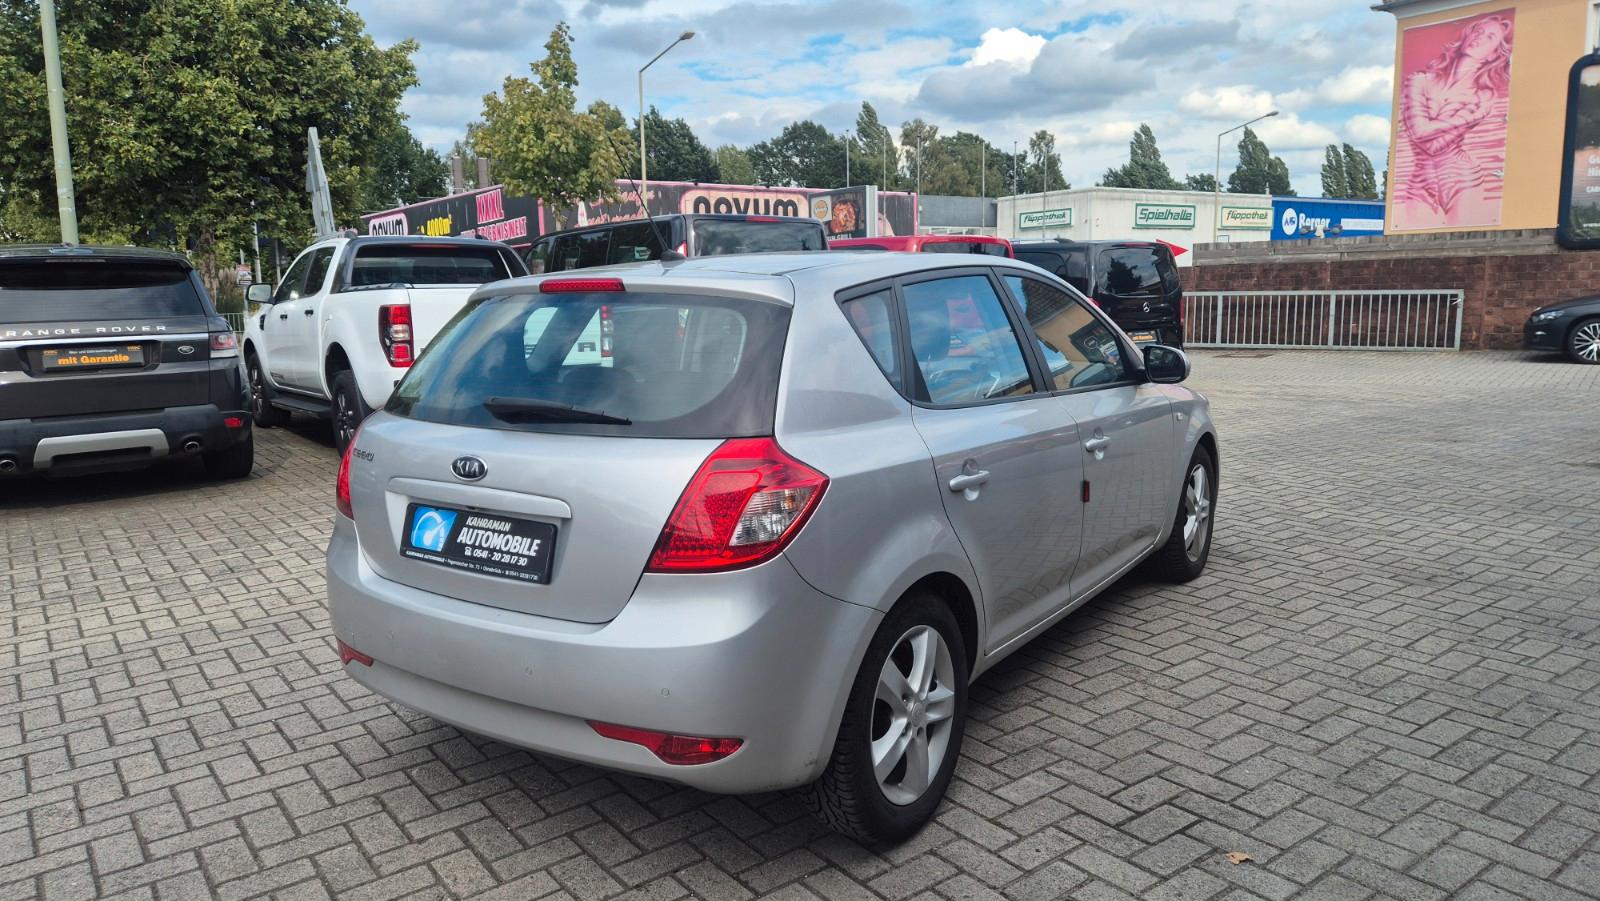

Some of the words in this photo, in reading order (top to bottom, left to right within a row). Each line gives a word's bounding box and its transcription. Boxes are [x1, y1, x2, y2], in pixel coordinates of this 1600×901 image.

[476, 190, 504, 224] XXXL
[693, 195, 798, 217] novum
[1139, 208, 1193, 223] Spielhalle
[6, 328, 81, 337] RANGE
[97, 325, 167, 333] ROVER
[58, 356, 77, 365] mit
[80, 354, 130, 364] Garantie
[456, 460, 480, 475] KIA
[466, 516, 512, 532] KAHRAMAN
[457, 527, 541, 557] AUTOMOBILE
[473, 550, 488, 559] 0541
[491, 551, 501, 561] 20
[511, 556, 518, 564] 17
[517, 557, 528, 567] 30
